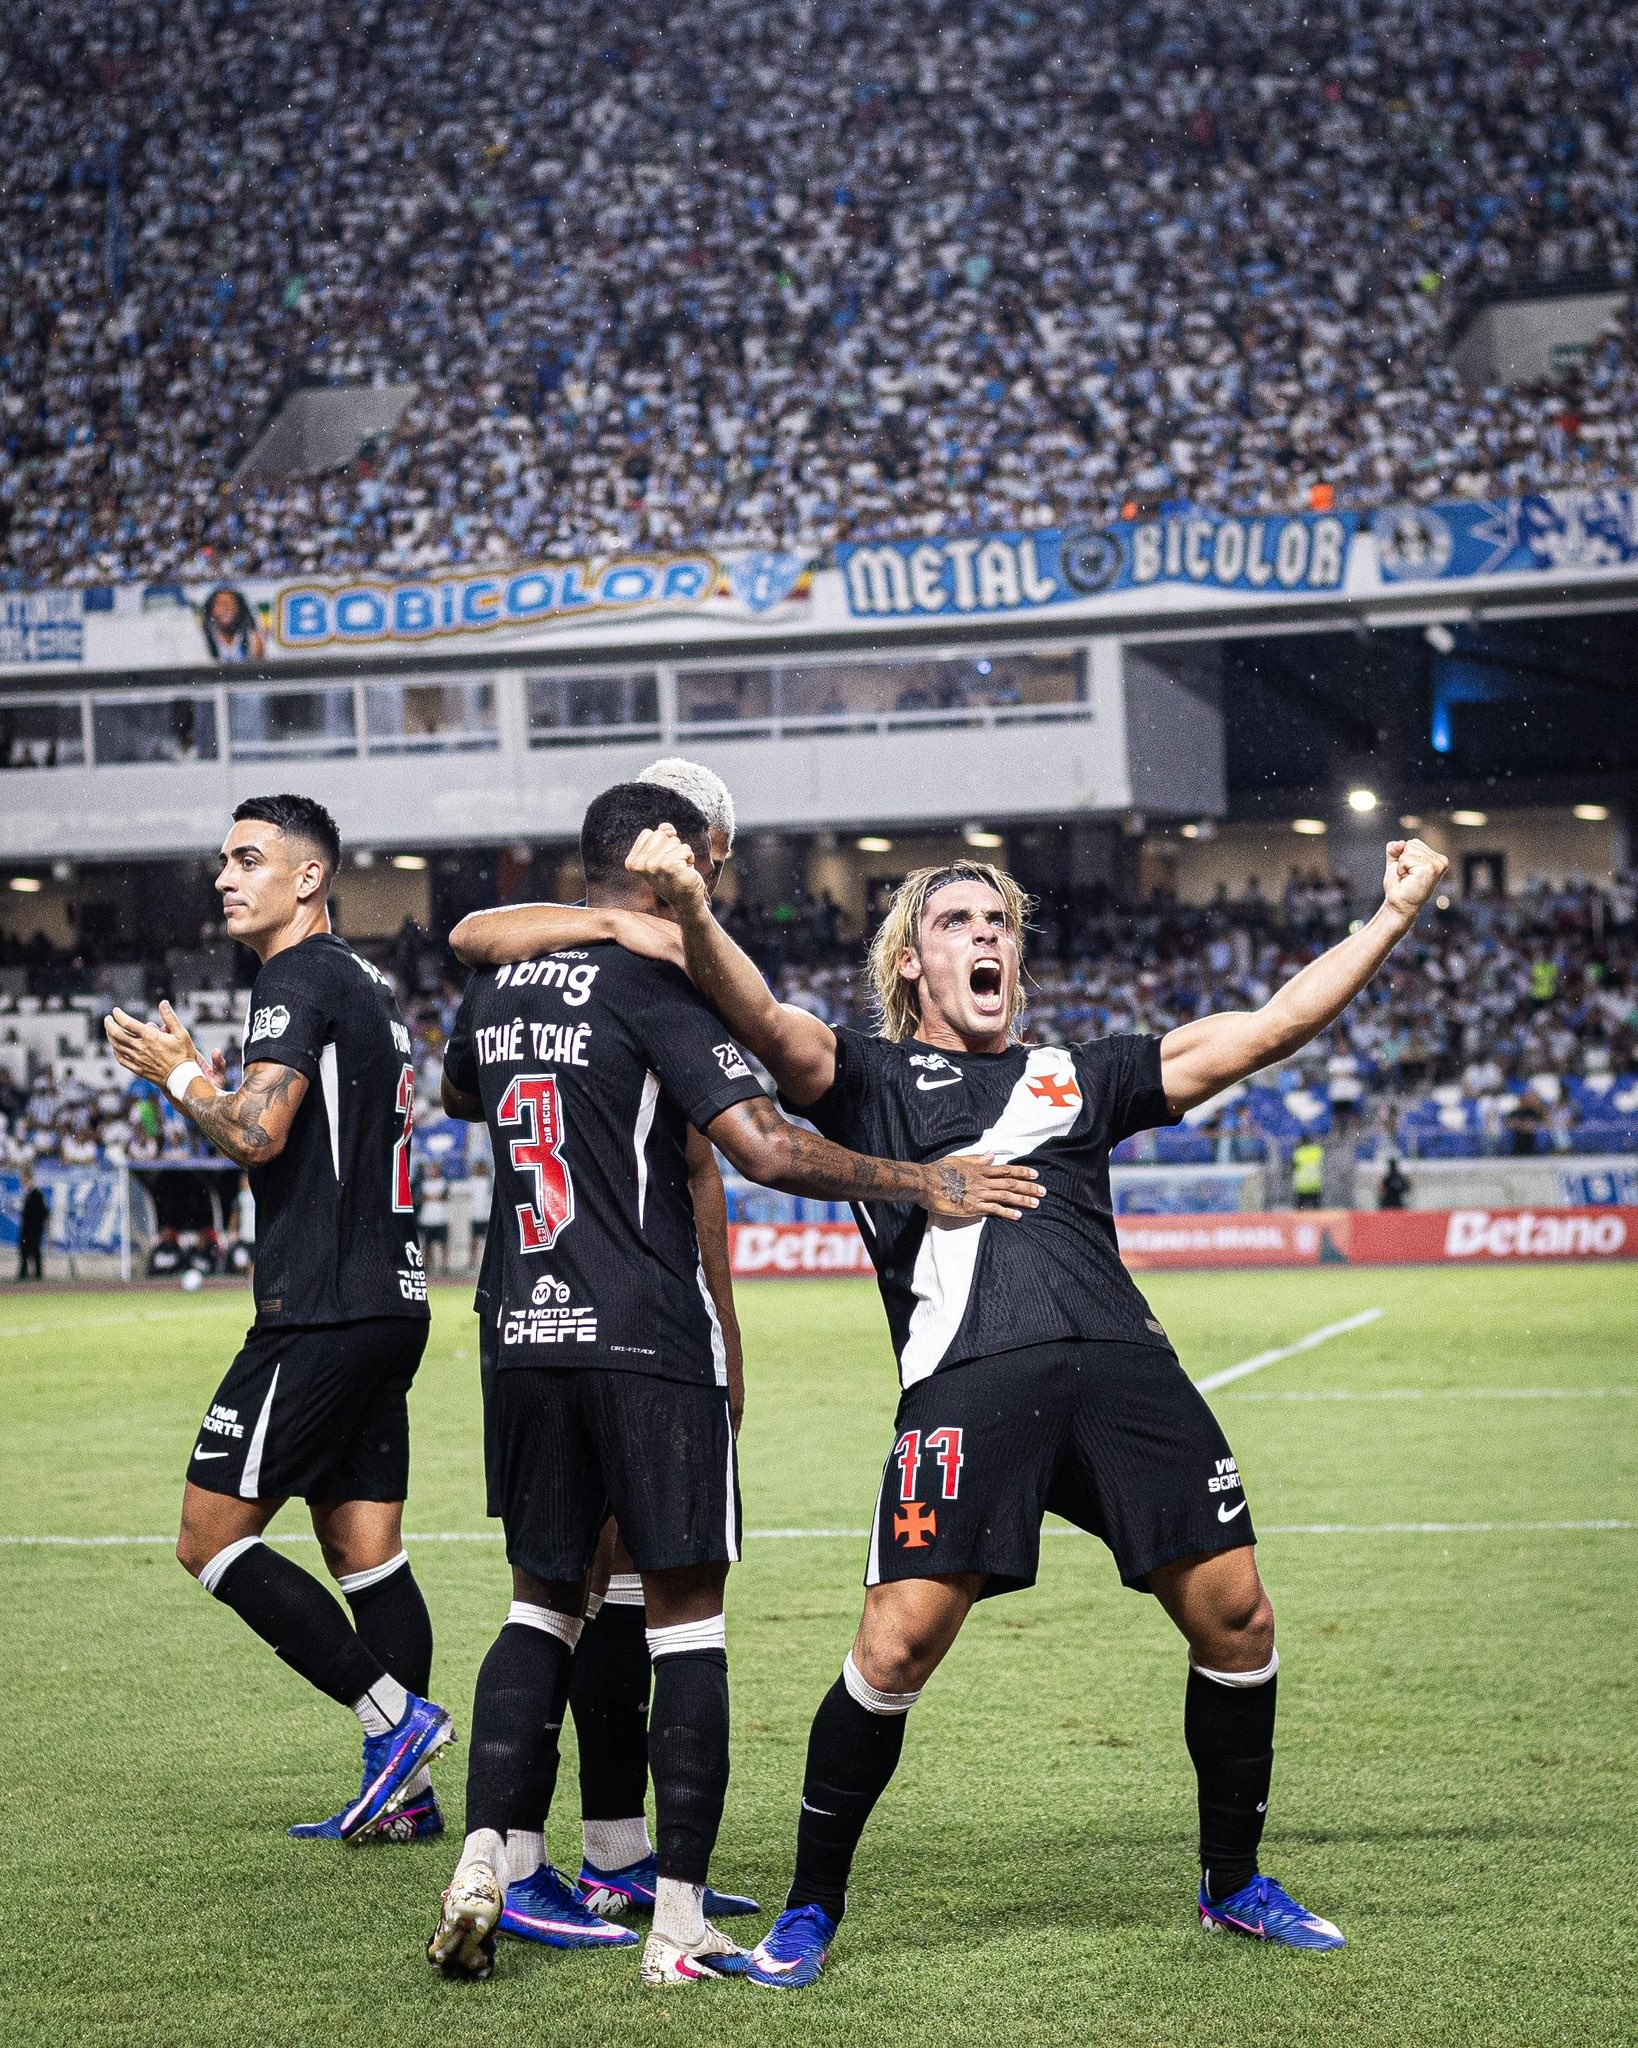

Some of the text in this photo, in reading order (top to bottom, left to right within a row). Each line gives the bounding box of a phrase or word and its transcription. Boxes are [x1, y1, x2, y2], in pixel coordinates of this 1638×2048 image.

[848, 517, 1345, 613] METAL BICOLOR
[509, 960, 600, 1007] bmg
[475, 1016, 593, 1067] TCHÊ TCHÊ
[497, 1073, 576, 1255] 3
[1445, 1210, 1628, 1256] Betano
[504, 1318, 598, 1345] CHEFE
[527, 1307, 570, 1320] MOTO
[202, 1415, 245, 1439] SORTE
[893, 1426, 965, 1501] 11
[1207, 1472, 1241, 1493] SORT
